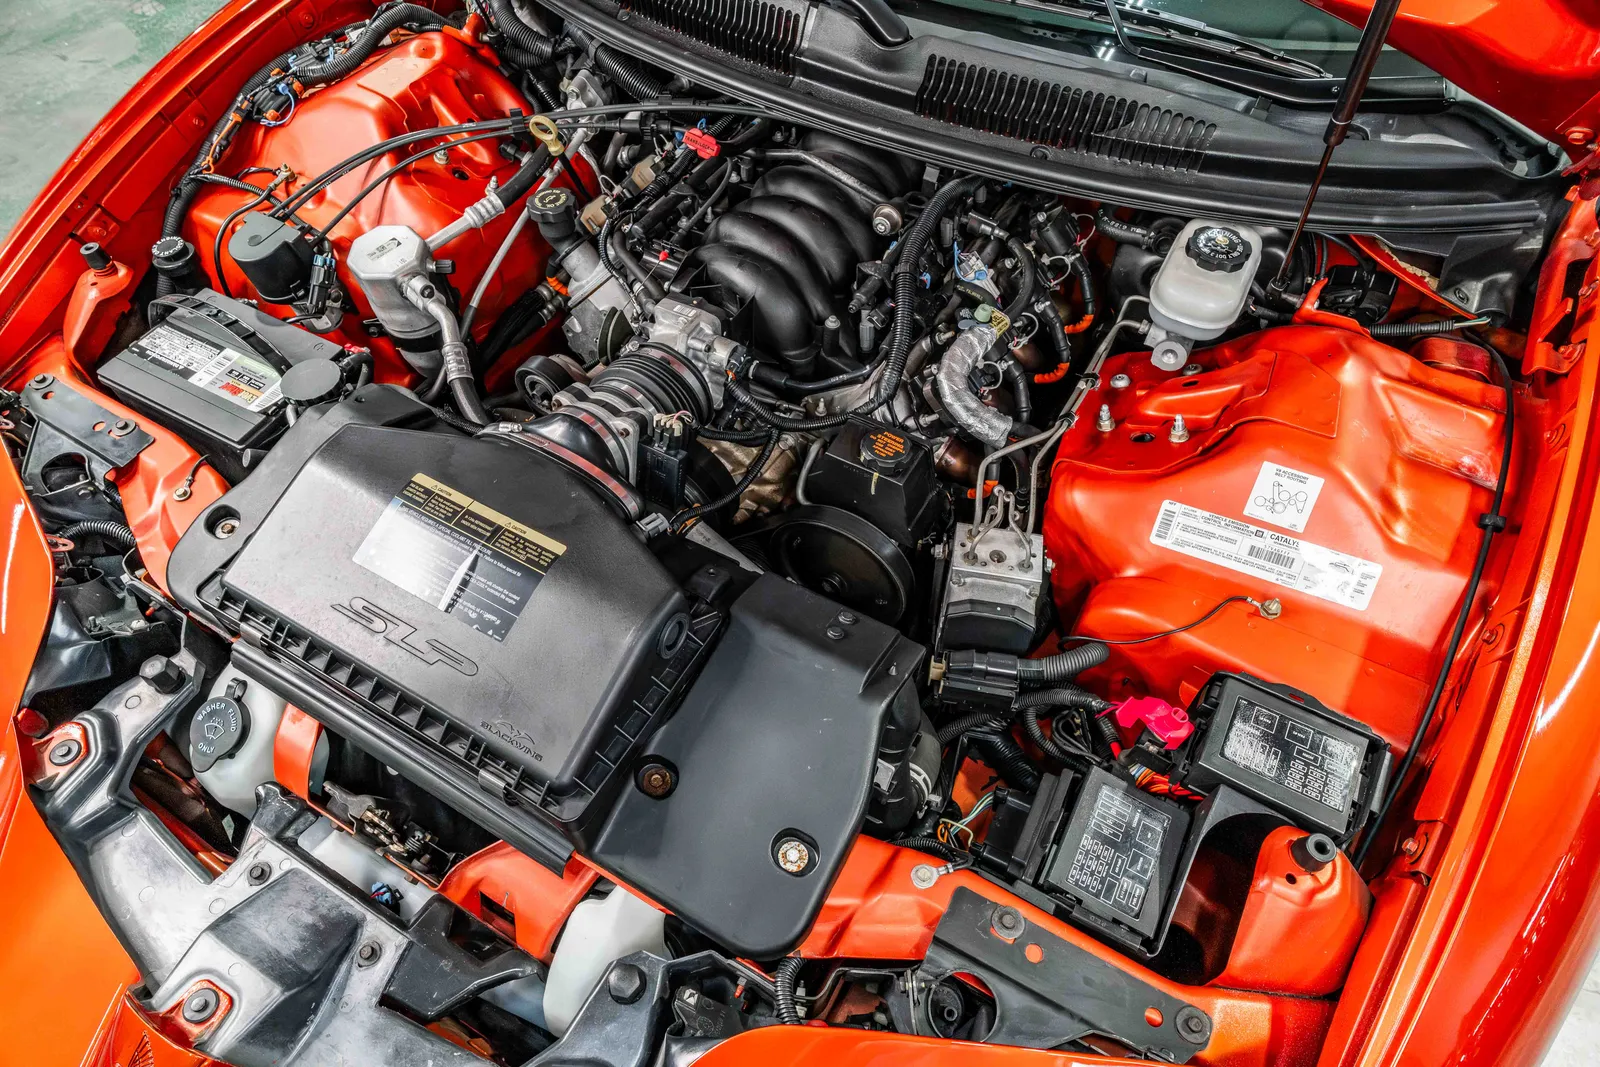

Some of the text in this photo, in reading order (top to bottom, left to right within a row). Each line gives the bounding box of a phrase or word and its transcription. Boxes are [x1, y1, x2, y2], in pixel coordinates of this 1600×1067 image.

[883, 430, 904, 443] POWER
[1281, 469, 1309, 481] ACCESSORY
[1286, 475, 1307, 484] ROUTING
[437, 487, 452, 497] CAUTION
[1200, 515, 1222, 525] CONTROL
[1222, 522, 1255, 535] INFORMATION
[1207, 513, 1227, 523] VEHICLE
[1227, 519, 1250, 529] EMISSION
[437, 524, 451, 534] SPECIAL
[450, 530, 466, 542] COOLANT
[510, 524, 527, 535] CAUTION
[330, 596, 477, 675] SLP
[196, 702, 225, 720] WASHER
[227, 708, 237, 731] FLUID
[198, 742, 215, 753] ONLY
[480, 719, 543, 762] BLACKWING
